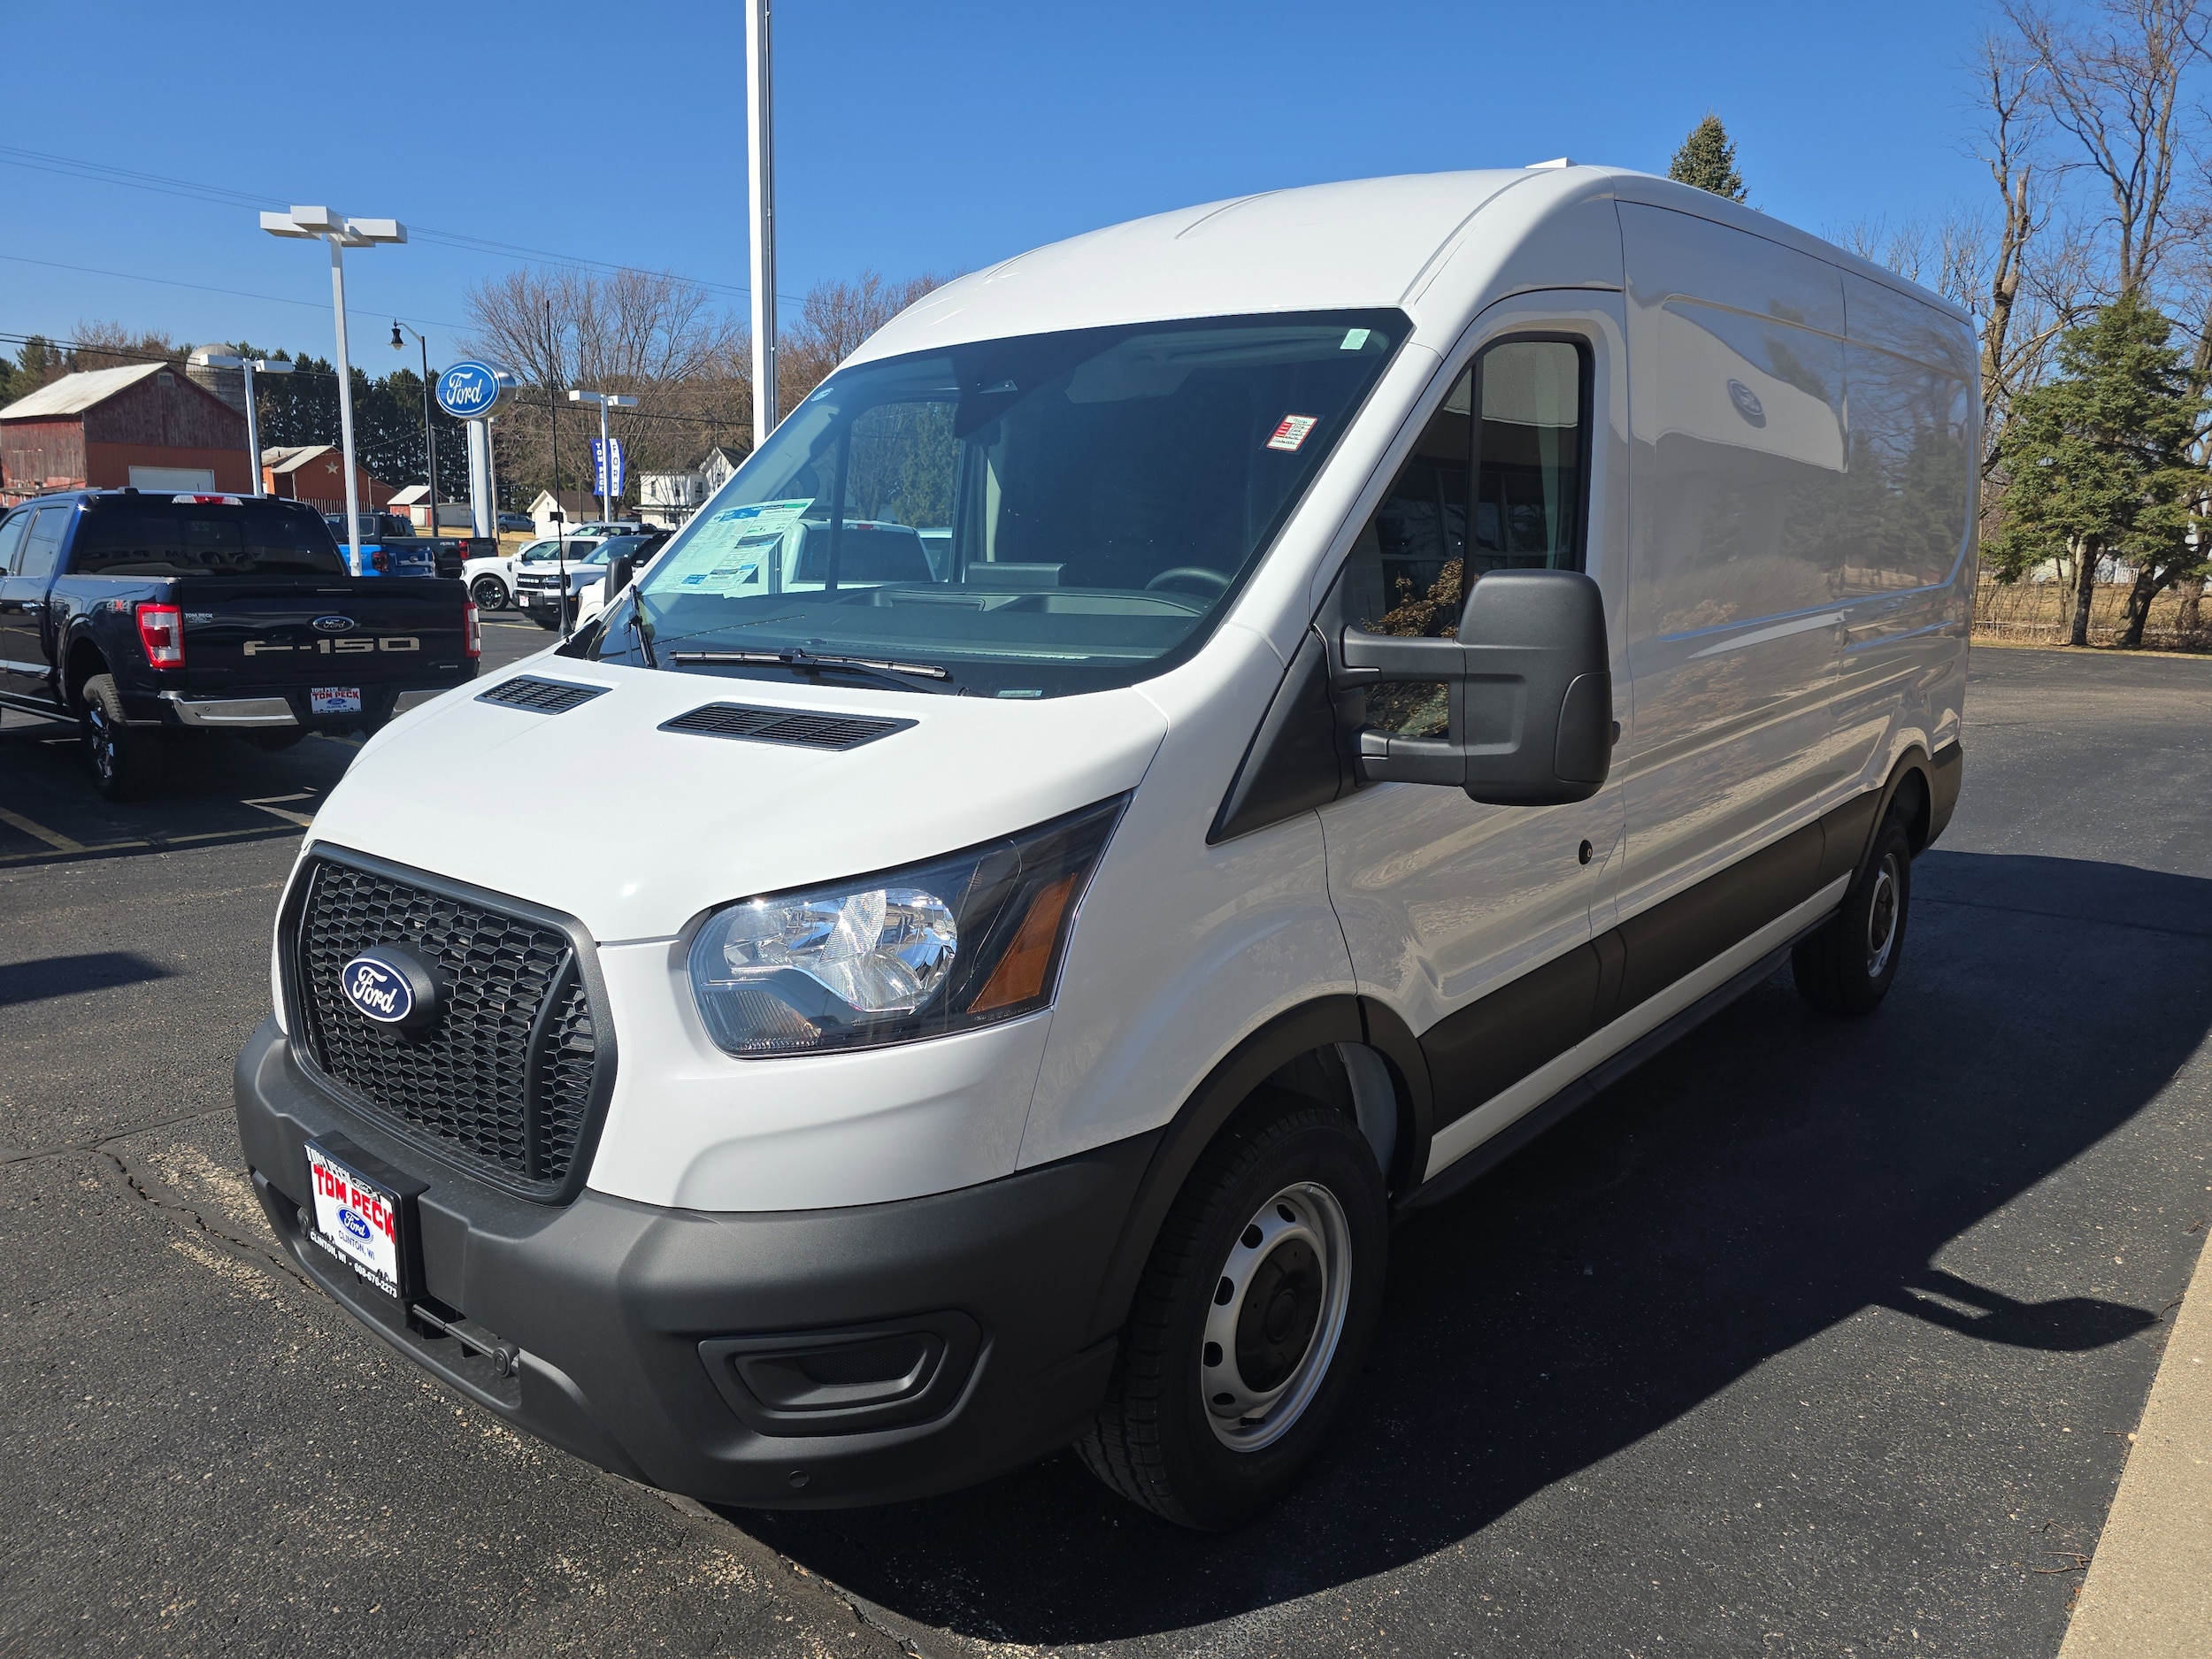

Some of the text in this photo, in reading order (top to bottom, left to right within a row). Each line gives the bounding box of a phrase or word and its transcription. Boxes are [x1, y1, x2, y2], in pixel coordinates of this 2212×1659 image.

[446, 372, 483, 405] Ford
[323, 618, 346, 629] Ford
[242, 636, 420, 657] F-150
[311, 692, 333, 701] TOM
[352, 965, 398, 1014] Ford
[313, 1164, 396, 1244] TOM PECK
[343, 1210, 366, 1237] Ford
[310, 1231, 338, 1260] CLINTON,
[337, 1250, 347, 1264] WI
[338, 1230, 375, 1261] CLINTON, WI
